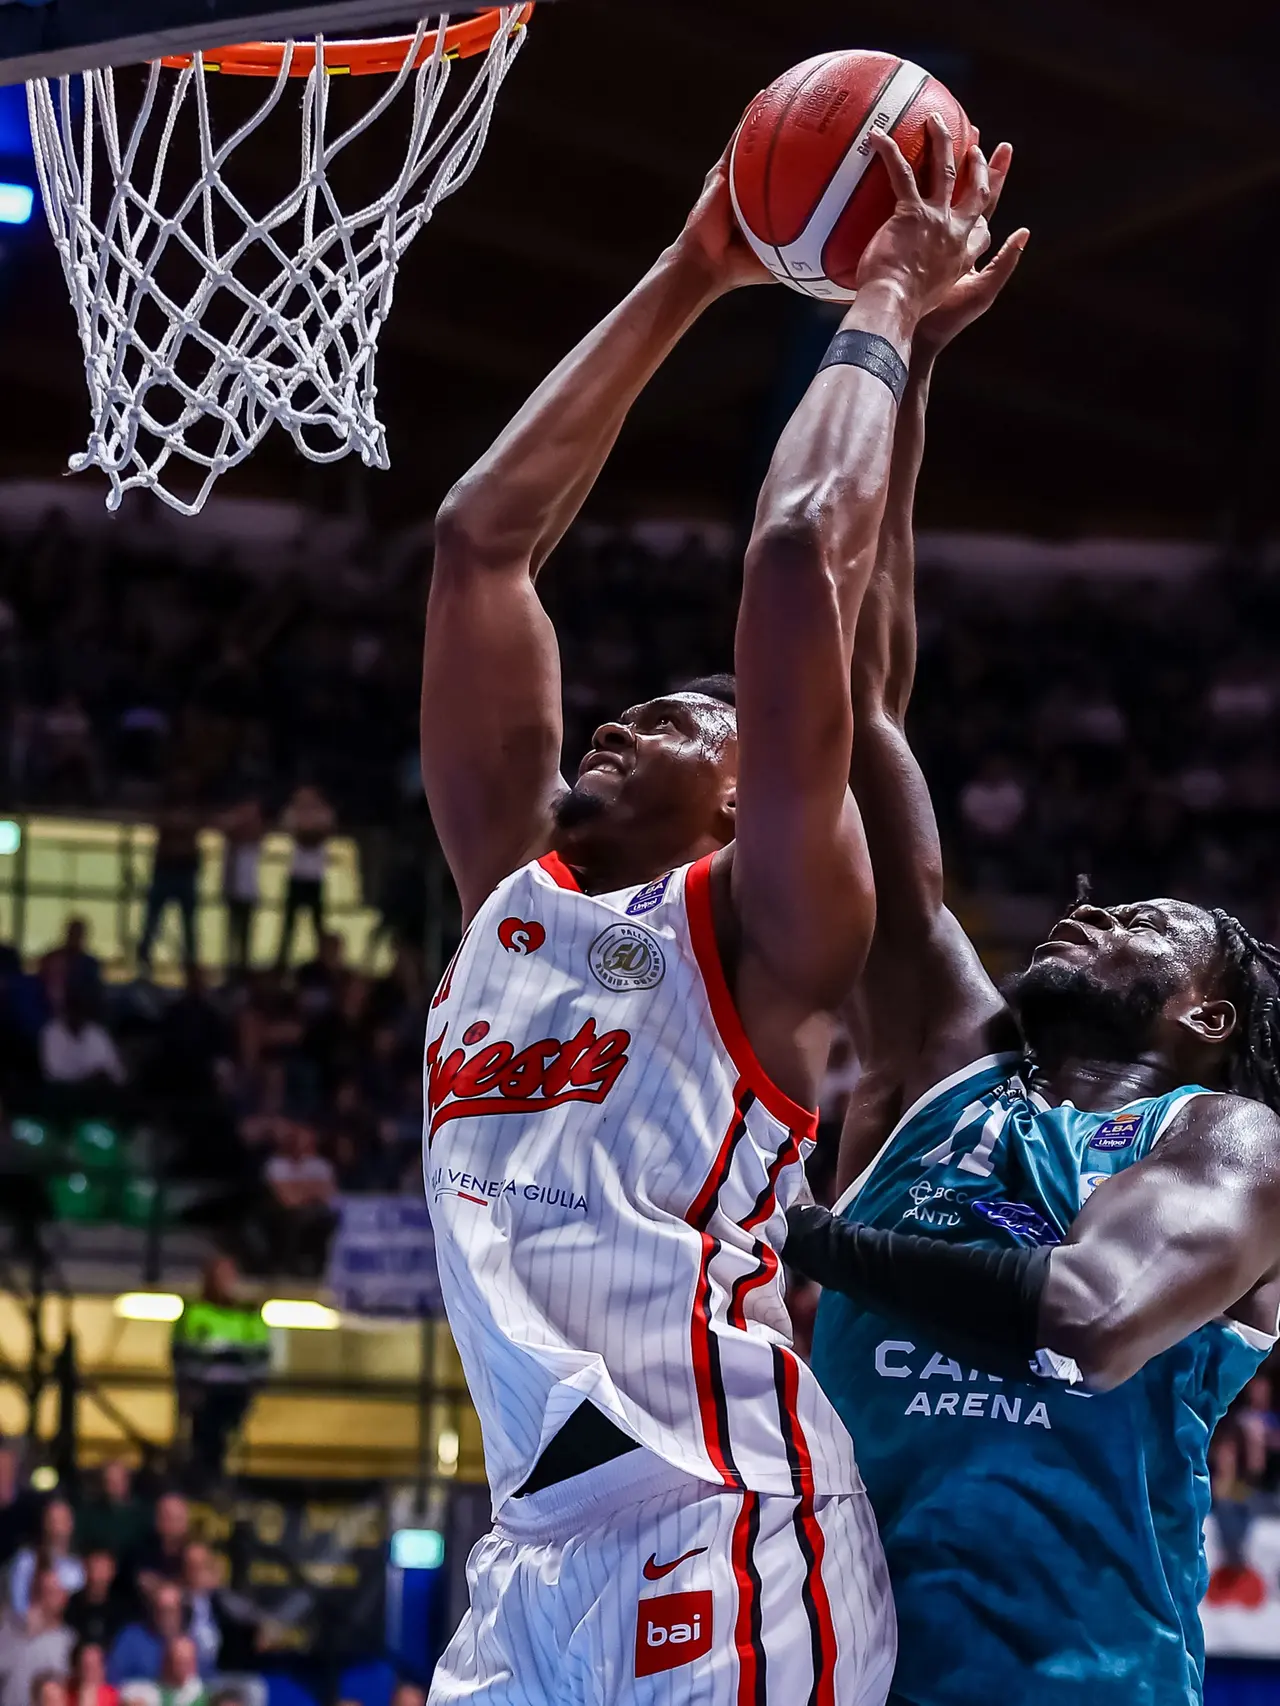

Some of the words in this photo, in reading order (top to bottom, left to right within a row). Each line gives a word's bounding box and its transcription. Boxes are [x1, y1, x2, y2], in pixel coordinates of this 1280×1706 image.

[603, 942, 650, 972] 50
[1095, 1138, 1127, 1148] Unipol
[1101, 1124, 1134, 1133] LBA
[523, 1184, 589, 1213] GIULIA
[933, 1187, 969, 1205] BCC
[904, 1391, 1052, 1430] ARENA
[646, 1613, 701, 1648] bai
